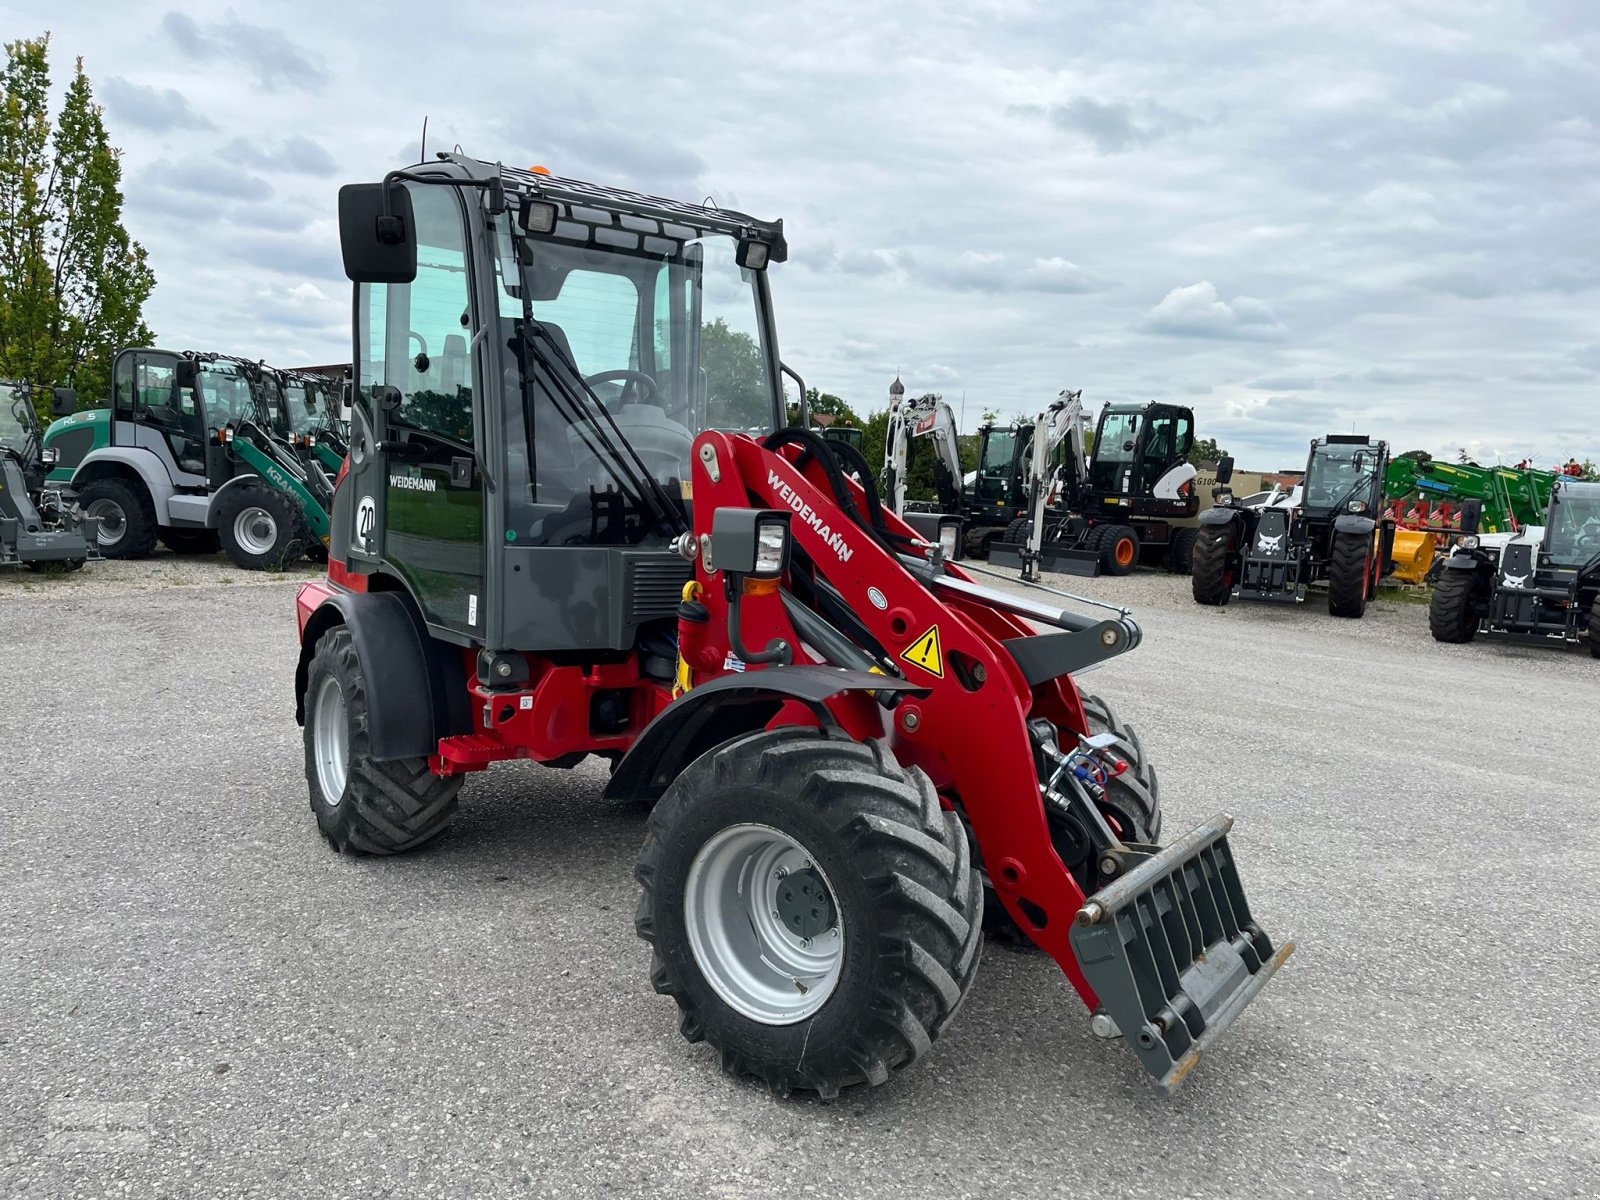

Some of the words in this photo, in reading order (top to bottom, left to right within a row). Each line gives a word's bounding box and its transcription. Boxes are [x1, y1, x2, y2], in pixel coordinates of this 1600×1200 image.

[389, 475, 436, 492] WEIDEMANN
[360, 505, 374, 538] 20
[767, 468, 854, 562] WEIDEMANN
